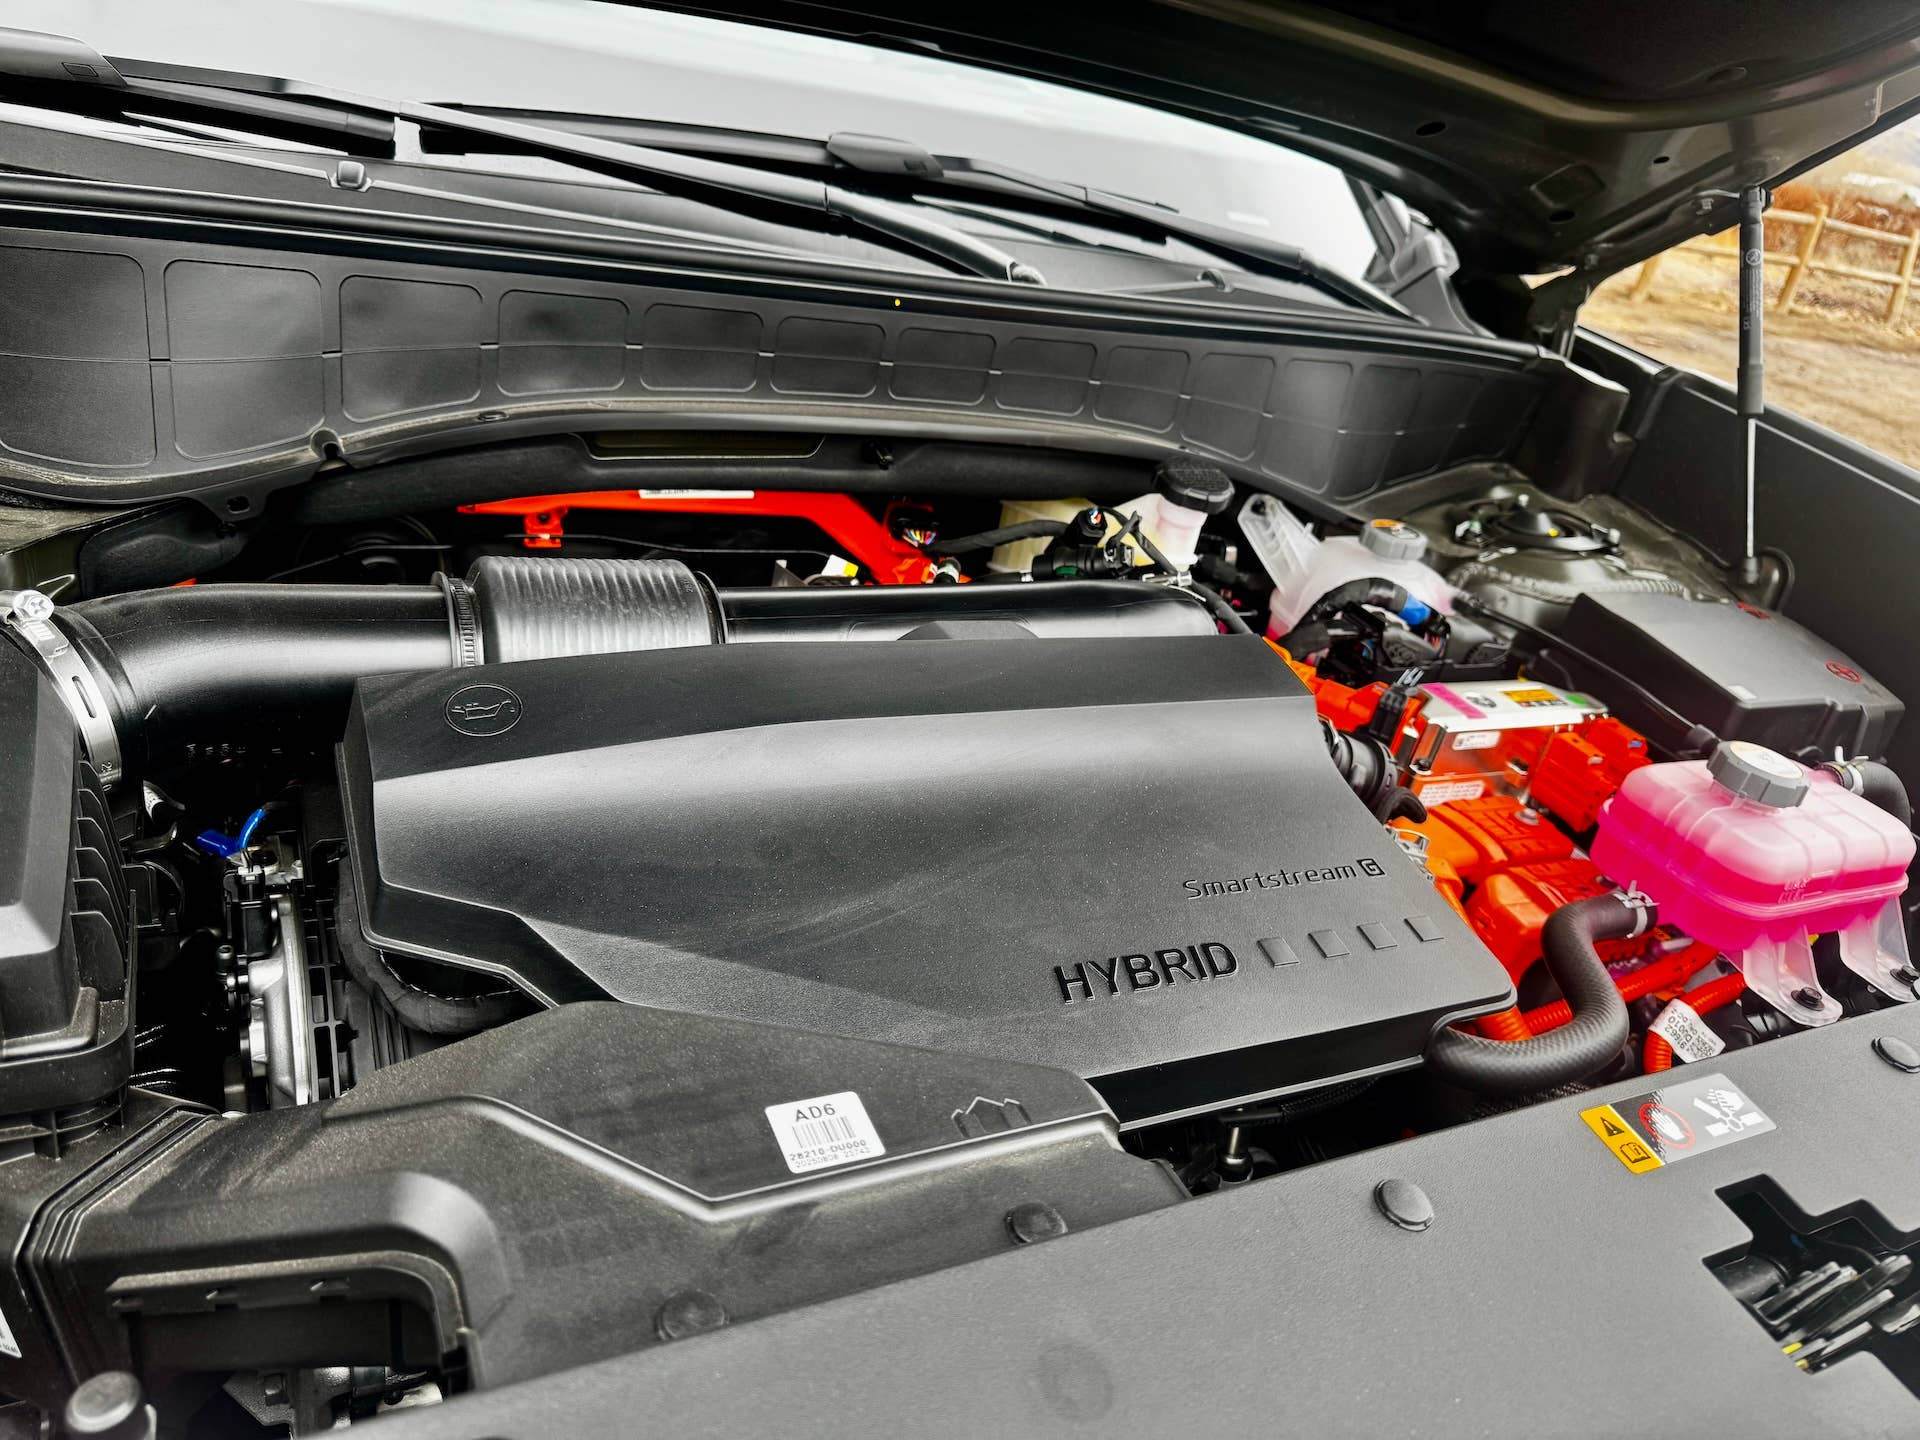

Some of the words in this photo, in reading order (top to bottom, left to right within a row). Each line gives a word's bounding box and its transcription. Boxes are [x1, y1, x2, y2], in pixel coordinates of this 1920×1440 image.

[1183, 865, 1357, 899] Smartstream
[1054, 943, 1238, 1004] HYBRID
[795, 1103, 836, 1121] AD6
